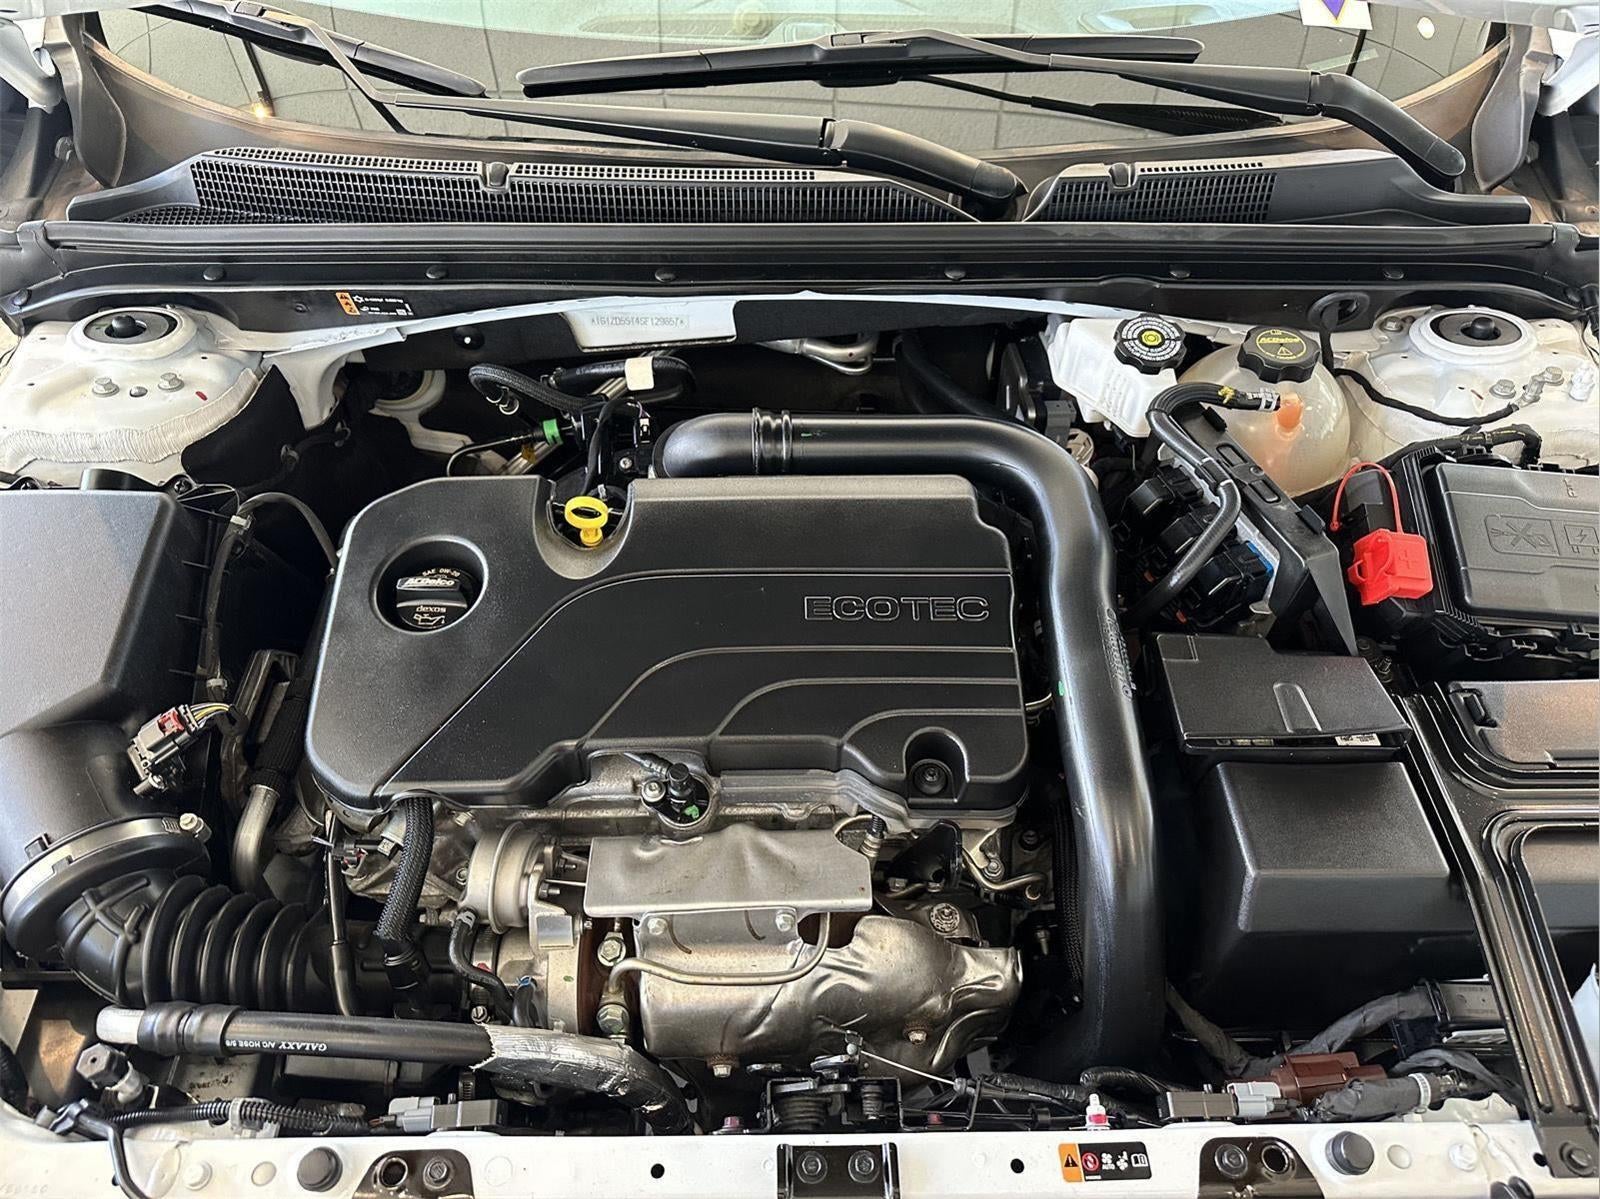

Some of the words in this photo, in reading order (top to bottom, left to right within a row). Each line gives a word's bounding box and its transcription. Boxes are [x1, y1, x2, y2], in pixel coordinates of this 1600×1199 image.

[423, 568, 435, 576] SAE
[403, 577, 454, 587] ACDelco
[416, 605, 446, 613] dexos
[804, 595, 990, 622] ECOTEC
[238, 1040, 261, 1048] HOSE
[279, 1041, 327, 1051] GALAXY
